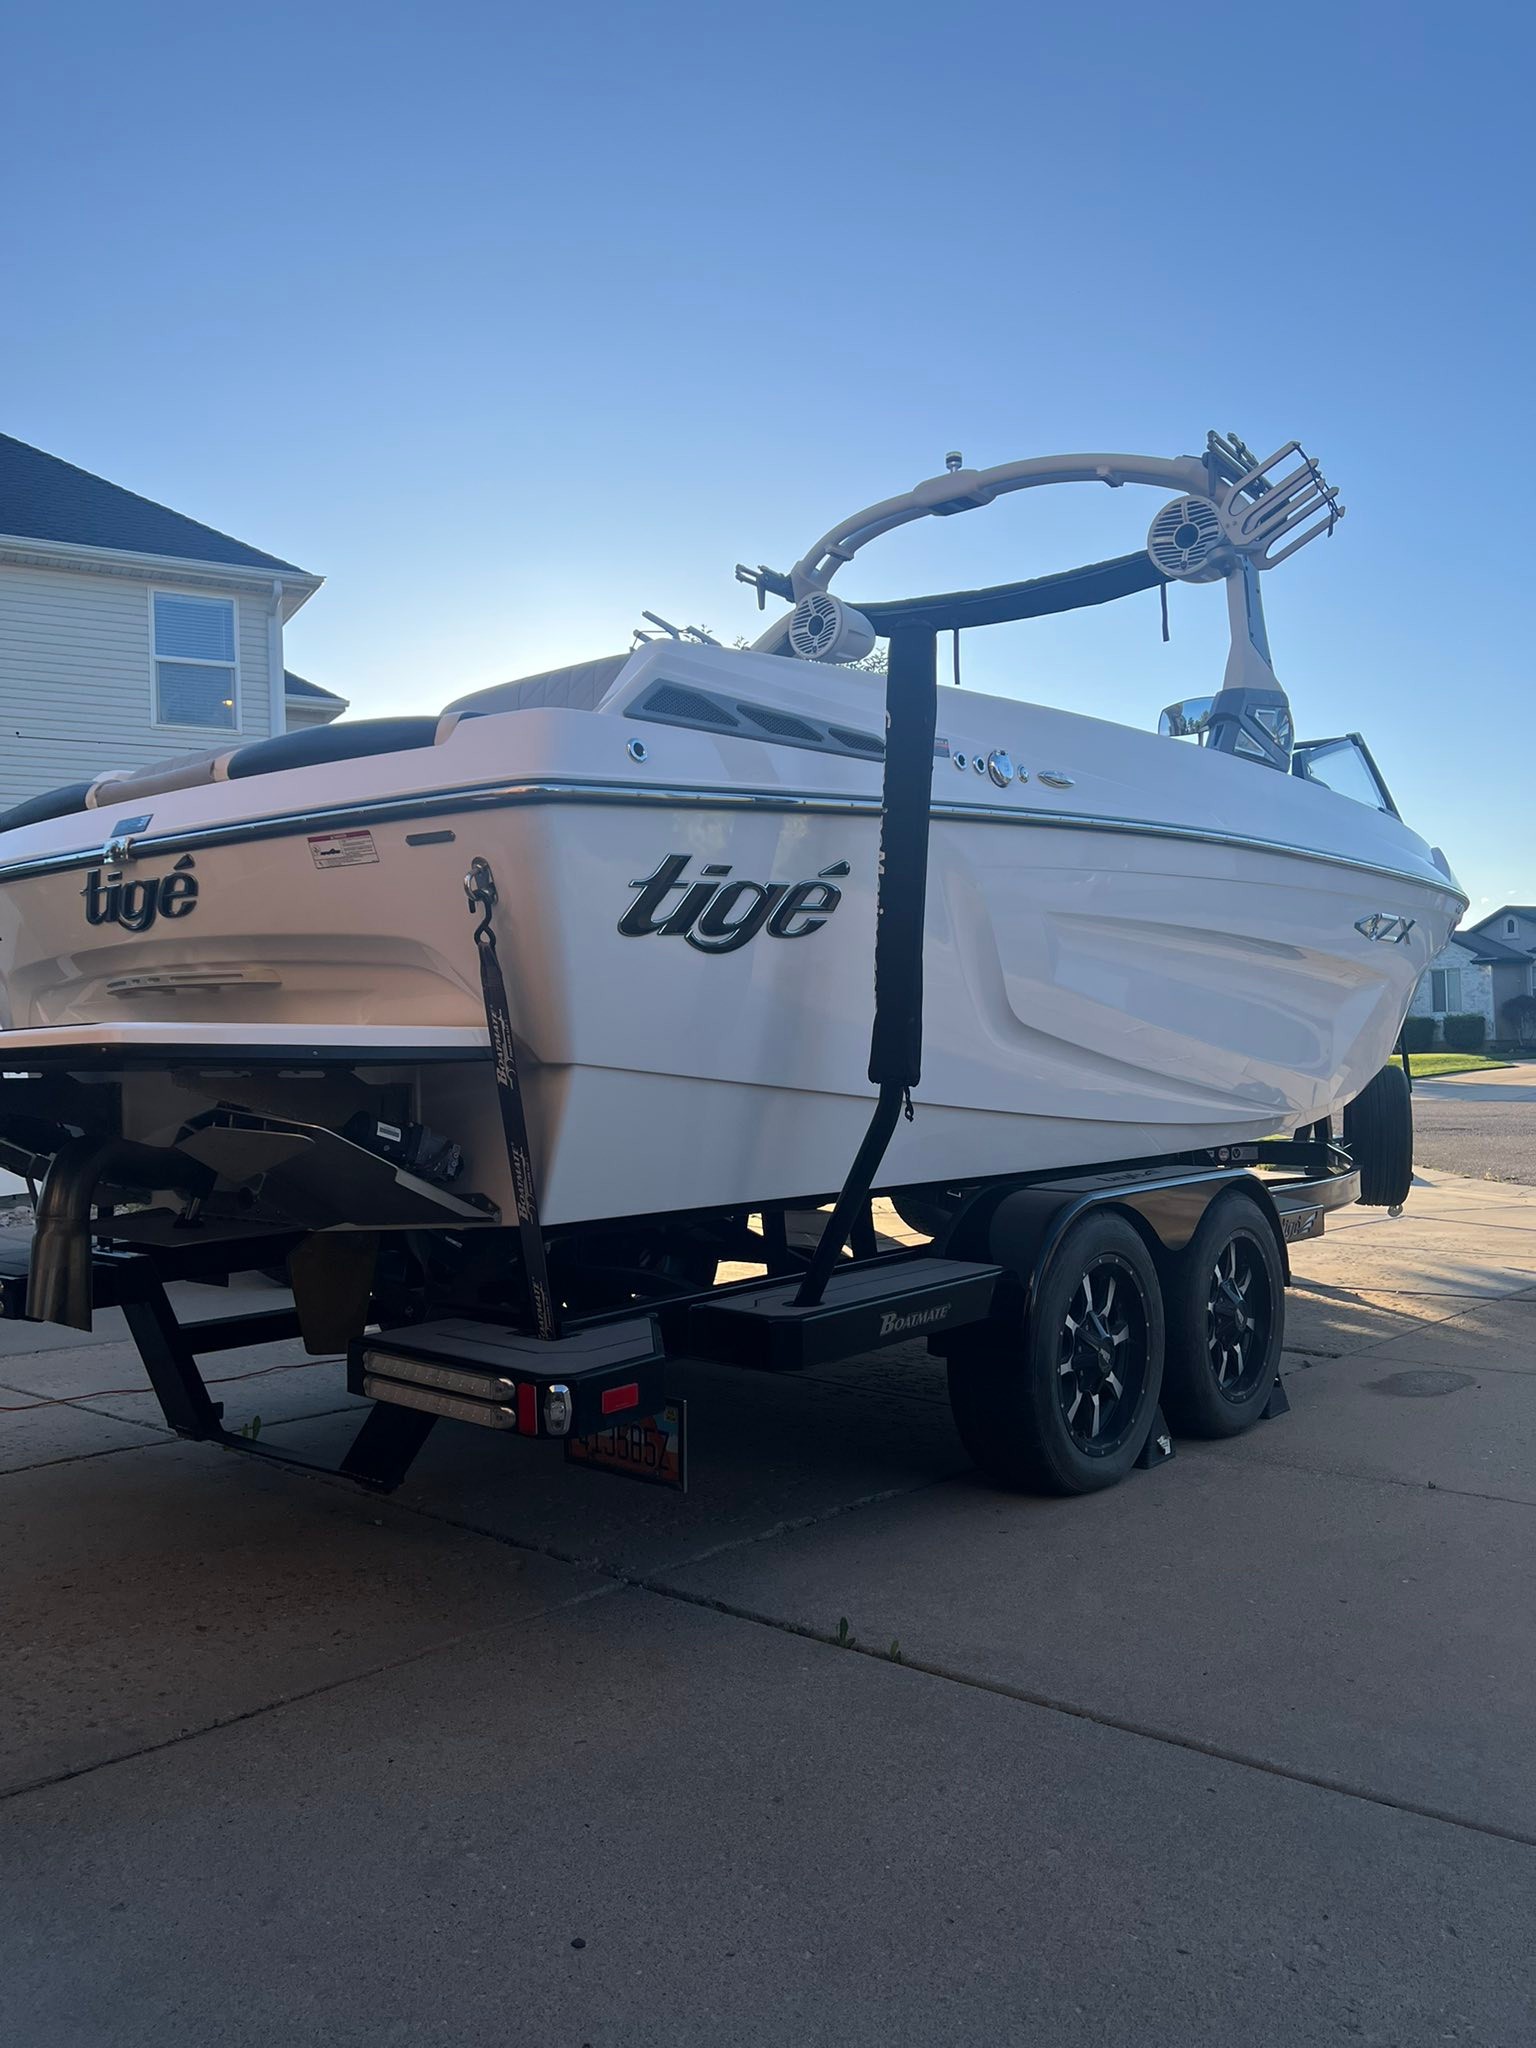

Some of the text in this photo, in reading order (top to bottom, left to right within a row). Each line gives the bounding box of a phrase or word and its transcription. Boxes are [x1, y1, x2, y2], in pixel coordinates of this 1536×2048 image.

[79, 853, 200, 933] tigé
[617, 852, 851, 955] tigé
[879, 1303, 949, 1337] BOATMATE
